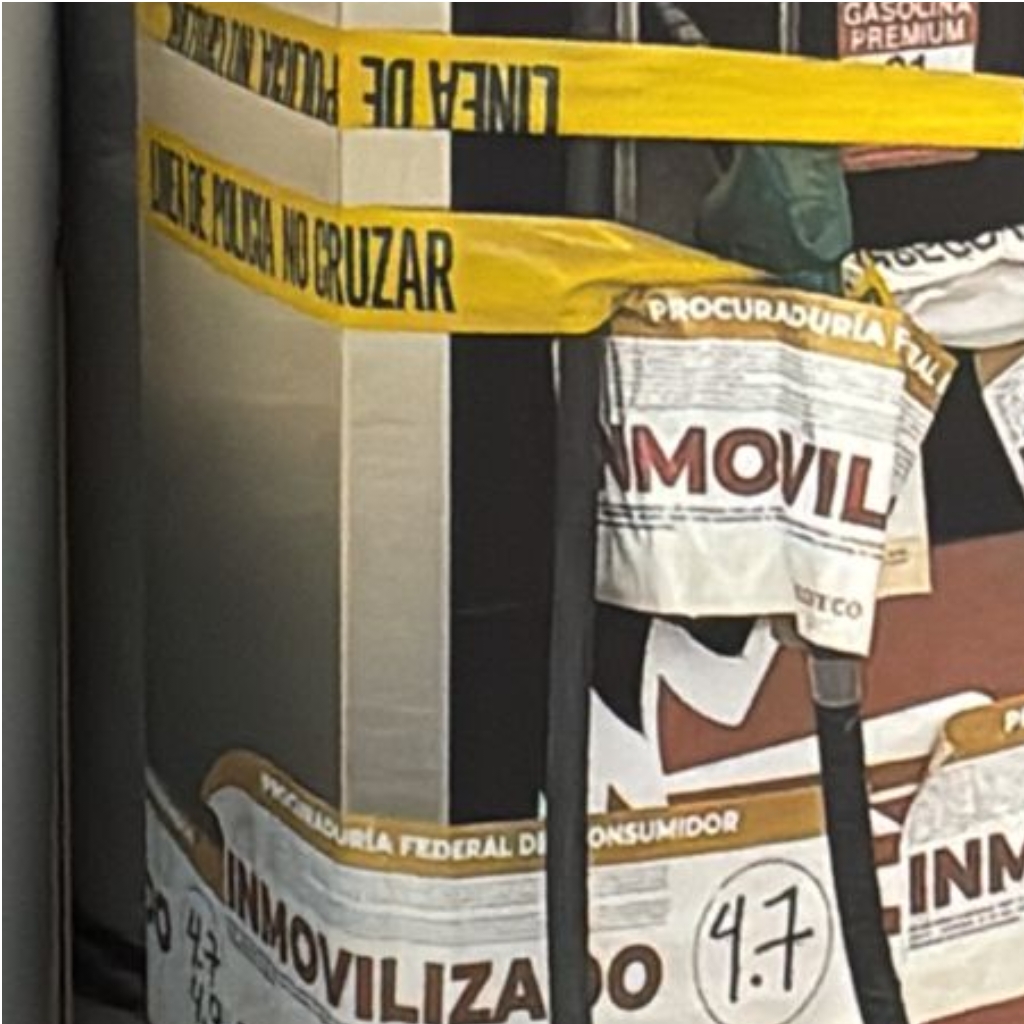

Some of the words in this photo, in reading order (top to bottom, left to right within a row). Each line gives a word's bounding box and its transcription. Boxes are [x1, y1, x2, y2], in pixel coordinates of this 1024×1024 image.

[843, 1, 972, 26] GASOLINA
[850, 18, 966, 51] PREMIUM
[361, 56, 414, 129] DE
[430, 60, 560, 135] LINEA
[212, 173, 275, 277] POLICIA
[282, 205, 309, 289] NO
[314, 217, 456, 313] CRUZAR
[647, 295, 887, 347] PROCURADURÍA
[601, 423, 887, 531] NMOVIL
[400, 833, 513, 862] FEDERAL
[588, 810, 741, 850] ONSUMIDOR
[709, 883, 815, 1005] 4.7
